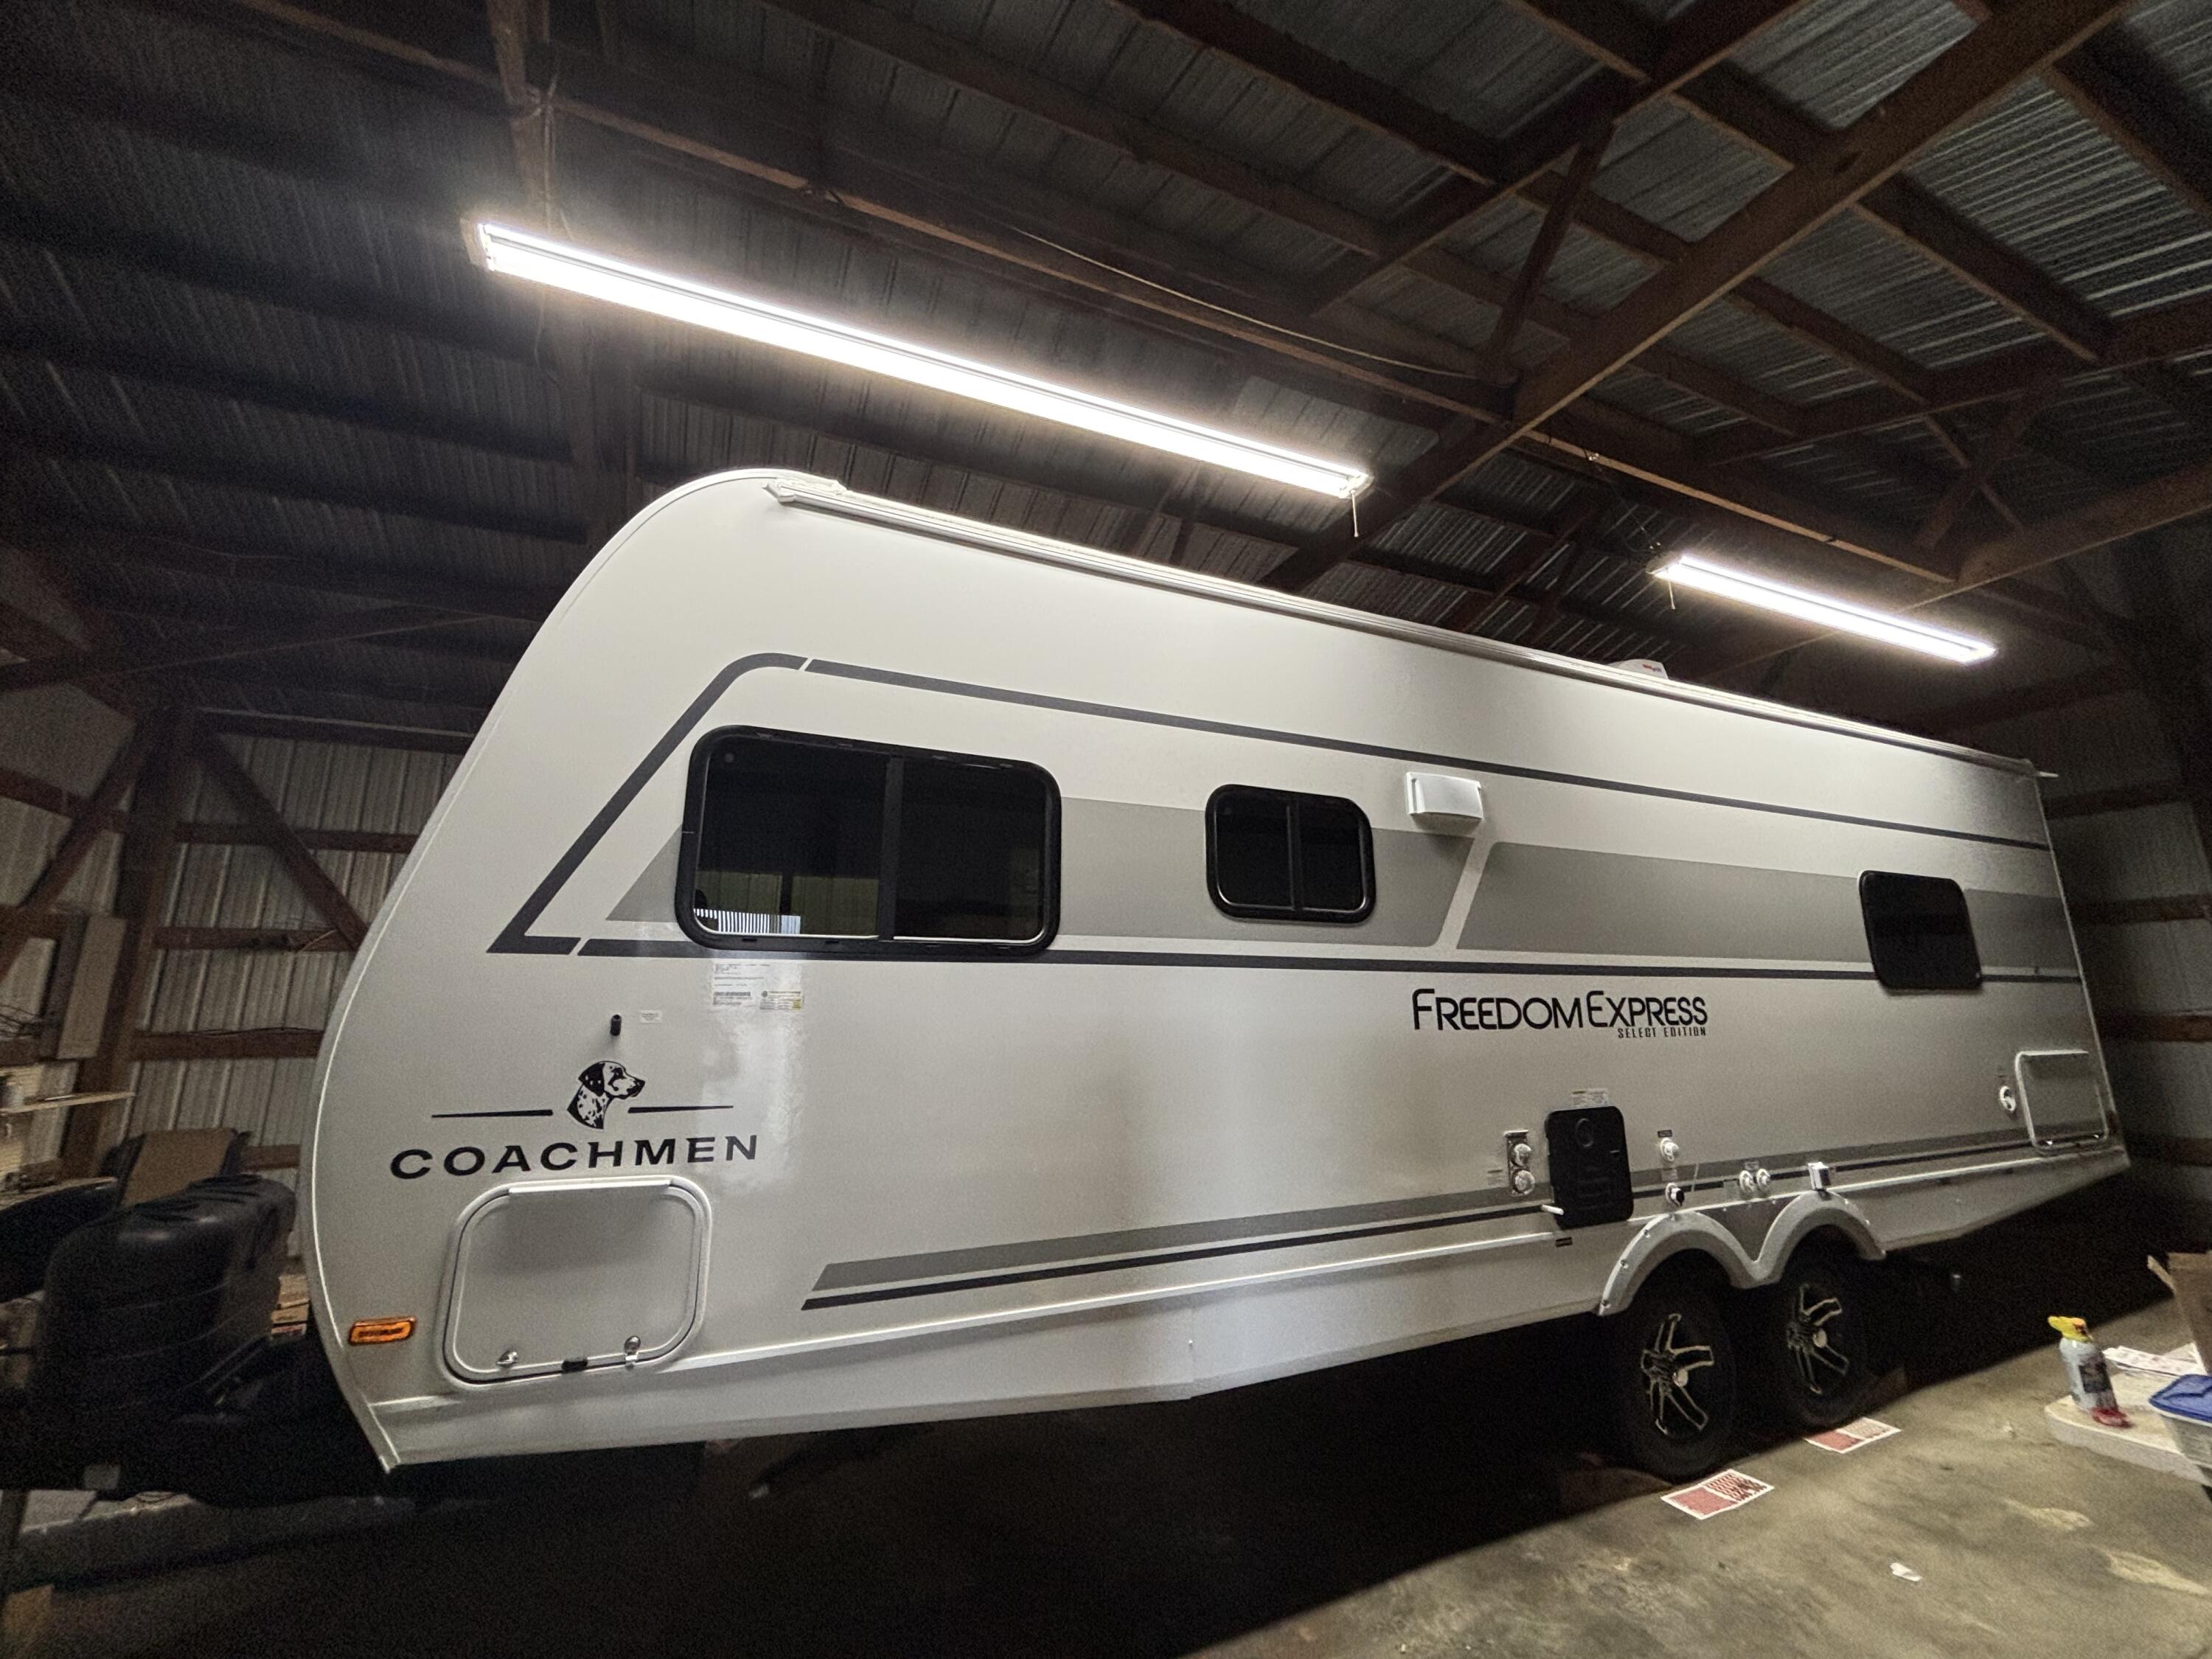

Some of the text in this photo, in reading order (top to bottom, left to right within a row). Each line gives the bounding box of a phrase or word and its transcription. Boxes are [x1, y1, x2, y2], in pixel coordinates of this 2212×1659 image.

[1618, 1026, 1706, 1038] SELECT EDITION
[390, 1135, 758, 1179] COACHMEN
